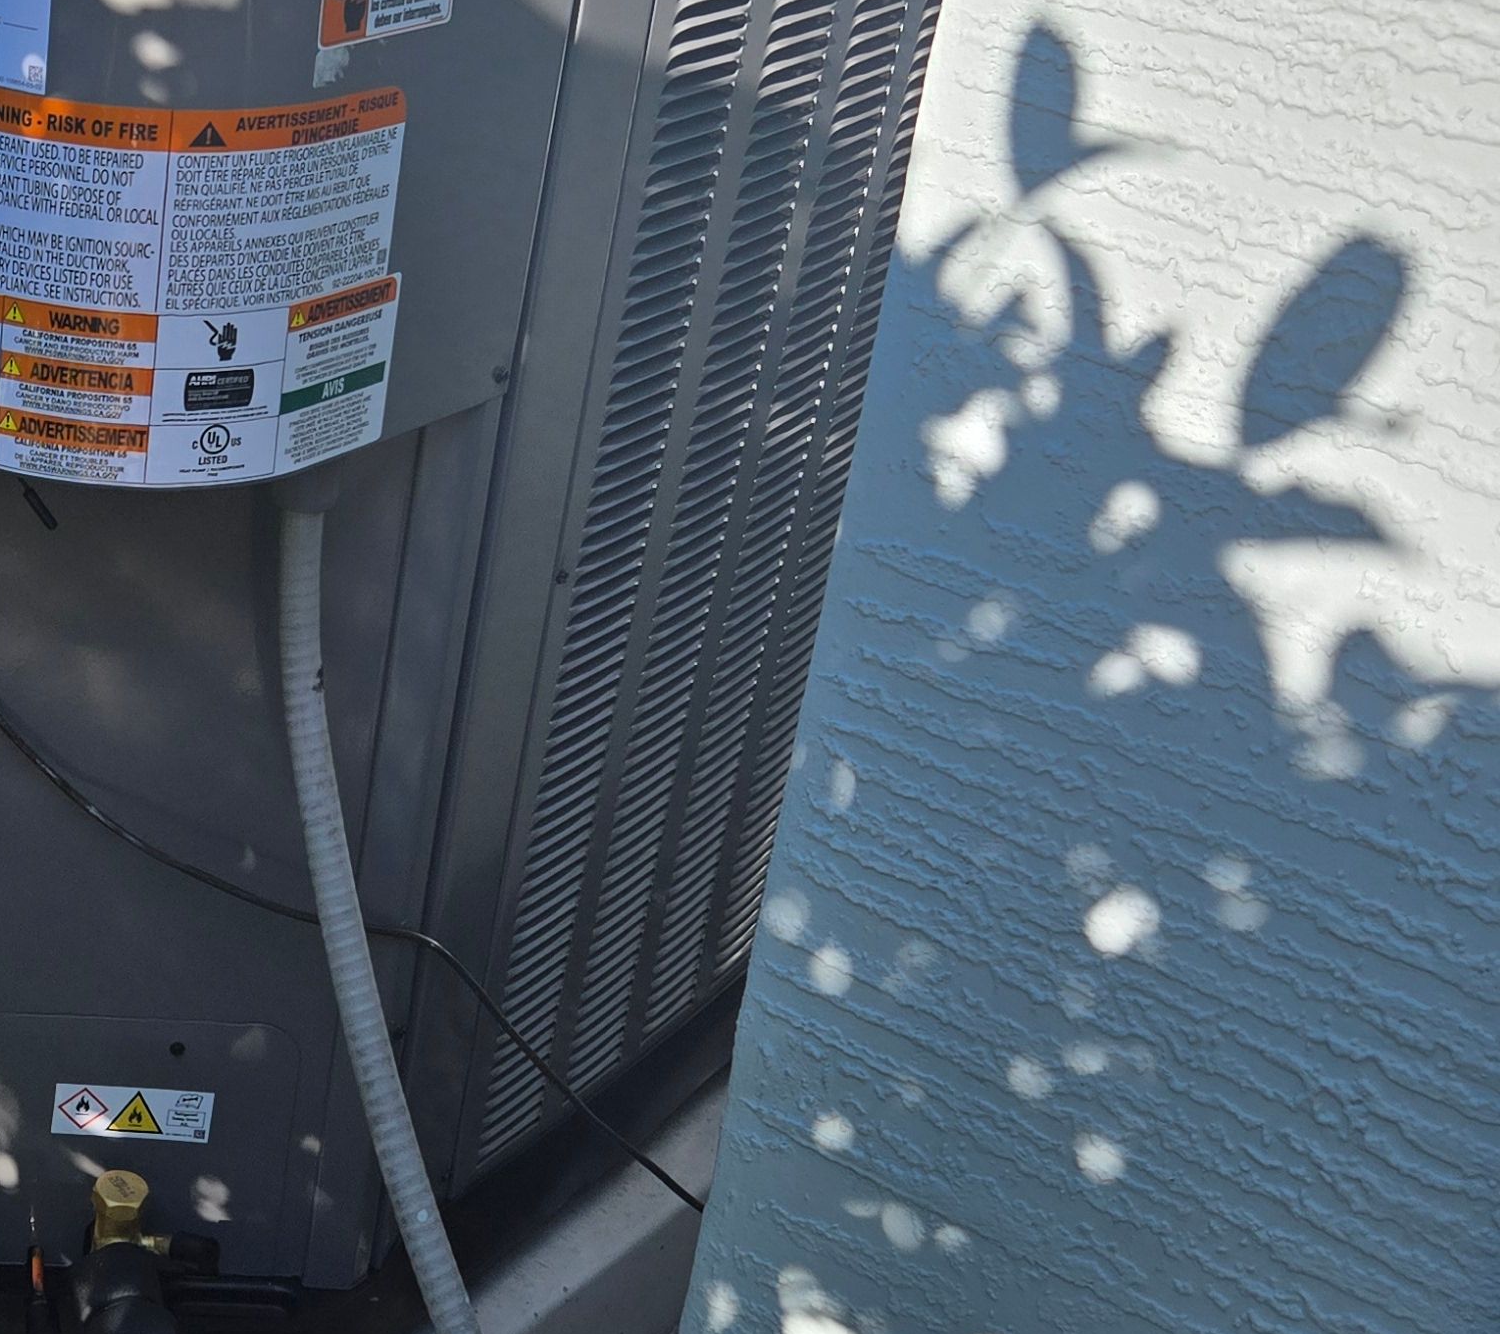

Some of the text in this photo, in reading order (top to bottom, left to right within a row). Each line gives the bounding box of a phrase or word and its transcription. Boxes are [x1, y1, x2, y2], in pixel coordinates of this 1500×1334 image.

[236, 91, 399, 132] AVERTISSEMENT RISQUE
[47, 113, 86, 136] RISK
[91, 120, 114, 138] OF
[119, 123, 159, 142] FIRE
[291, 118, 359, 146] D'INCENDIE
[31, 142, 60, 161] USED.
[62, 146, 76, 163] TO
[78, 148, 91, 165] BE
[93, 150, 144, 170] REPAIRED
[177, 151, 282, 169] CONTIENT UN FLUIDE
[92, 168, 110, 185] DO
[111, 171, 135, 187] NOT
[176, 170, 202, 183] DOIT
[267, 165, 287, 179] QUE
[289, 162, 306, 175] PAR
[307, 160, 319, 173] UN
[21, 177, 59, 199] TUBING
[61, 184, 105, 205] DISPOSE
[106, 190, 122, 206] OF
[175, 182, 199, 196] TIEN
[250, 181, 264, 194] NE
[264, 178, 282, 192] PAS
[283, 173, 315, 189] PERCER
[31, 197, 57, 215] WITH
[59, 201, 104, 221] FEDERAL
[106, 207, 122, 223] OR
[125, 208, 159, 225] LOCAL
[246, 196, 259, 208] NE
[260, 193, 284, 207] DOIT
[172, 209, 280, 228] CONFORMÉMENT AUX
[27, 230, 49, 247] MAY
[51, 233, 63, 250] BE
[65, 236, 112, 256] IGNITION
[114, 241, 155, 259] SOURC-
[170, 232, 304, 253] LES APPAREILS ANNEXES QUI
[171, 227, 237, 241] OU LOCALES.
[33, 248, 43, 263] IN
[45, 250, 64, 266] THE
[169, 245, 302, 268] DES D'INCENDIE NE
[12, 260, 51, 281] DEVICES
[53, 267, 88, 286] LISTED
[90, 272, 111, 289] FOR
[113, 275, 133, 290] USE
[208, 258, 304, 282] DANS LES CONDUITES
[43, 283, 61, 300] SEE
[63, 287, 141, 308] INSTRUCTIONS.
[166, 273, 301, 297] AUTRES QUE CEUX DE LA LISTE
[165, 293, 264, 310] EIL VOIR
[308, 282, 391, 322] ADVERTISSEMENT
[49, 310, 120, 336] WARNING
[298, 308, 383, 344] TENSION DANGEREUSE
[13, 336, 42, 348] CANCER
[43, 341, 59, 351] AND
[61, 344, 116, 357] REPRODUCTIVE
[22, 328, 69, 344] CALIFORNIA
[70, 336, 125, 351] PROPOSITION
[31, 362, 134, 392] ADVERTENCIA
[321, 377, 345, 399] AVIS
[15, 391, 131, 412] CANCER REPRODUCTIVO
[18, 383, 121, 403] CALIFORNIA PROPOSITION
[18, 416, 148, 448] ADVERTISSEMENT
[207, 431, 222, 448] UL
[231, 437, 242, 447] US
[29, 450, 58, 461] CANCER
[71, 455, 109, 466] TROUBLES
[198, 455, 228, 466] LISTED
